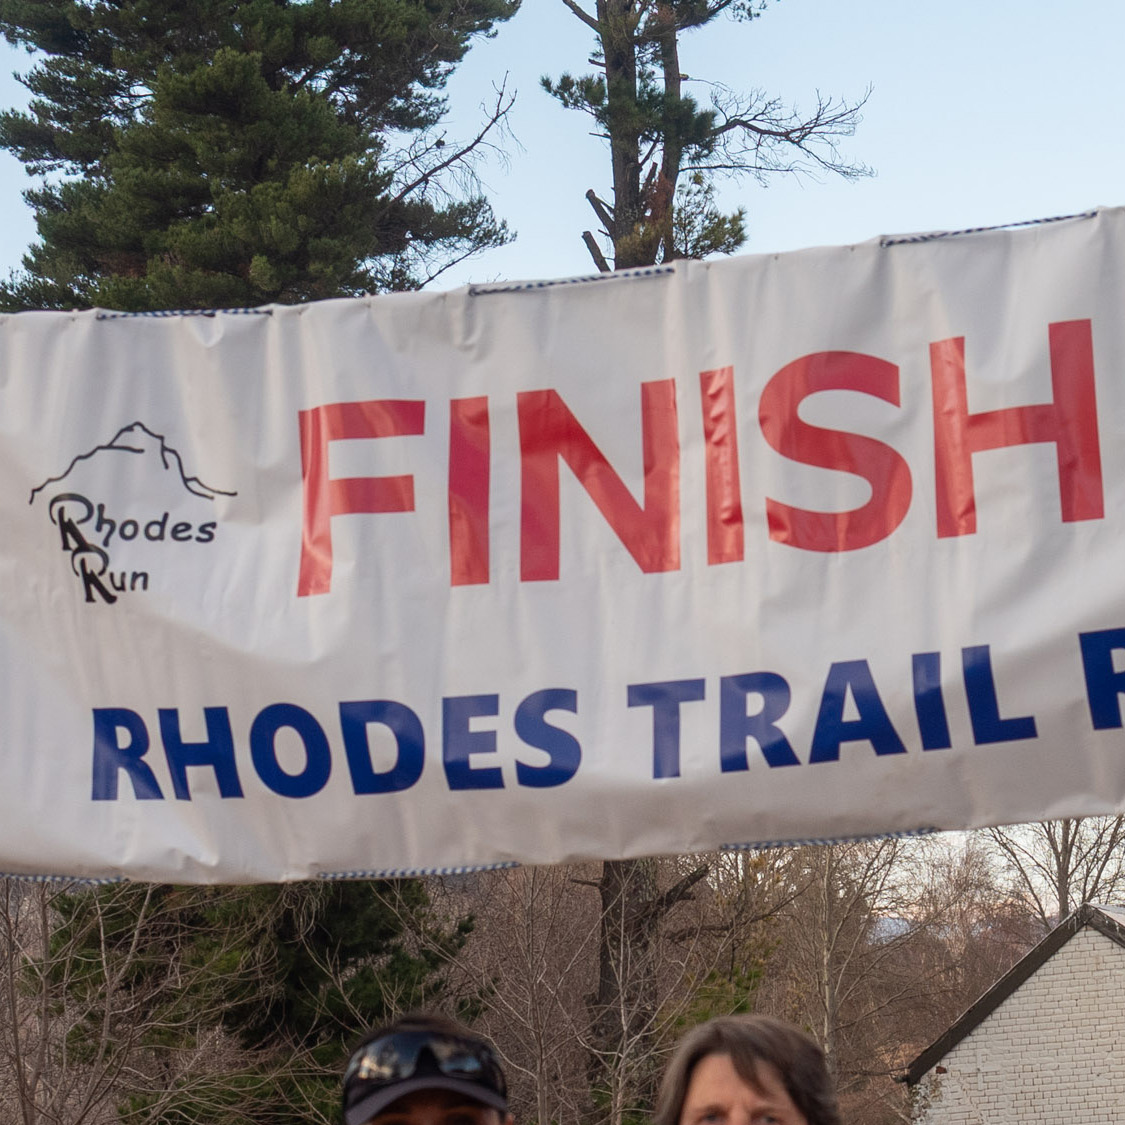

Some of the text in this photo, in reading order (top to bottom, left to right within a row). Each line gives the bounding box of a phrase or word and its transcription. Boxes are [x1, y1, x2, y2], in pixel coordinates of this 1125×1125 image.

[296, 318, 1106, 598] FINISH
[49, 493, 217, 552] Rhodes
[71, 545, 149, 603] Run
[91, 687, 583, 801] RHODES
[626, 644, 1039, 780] TRAIL
